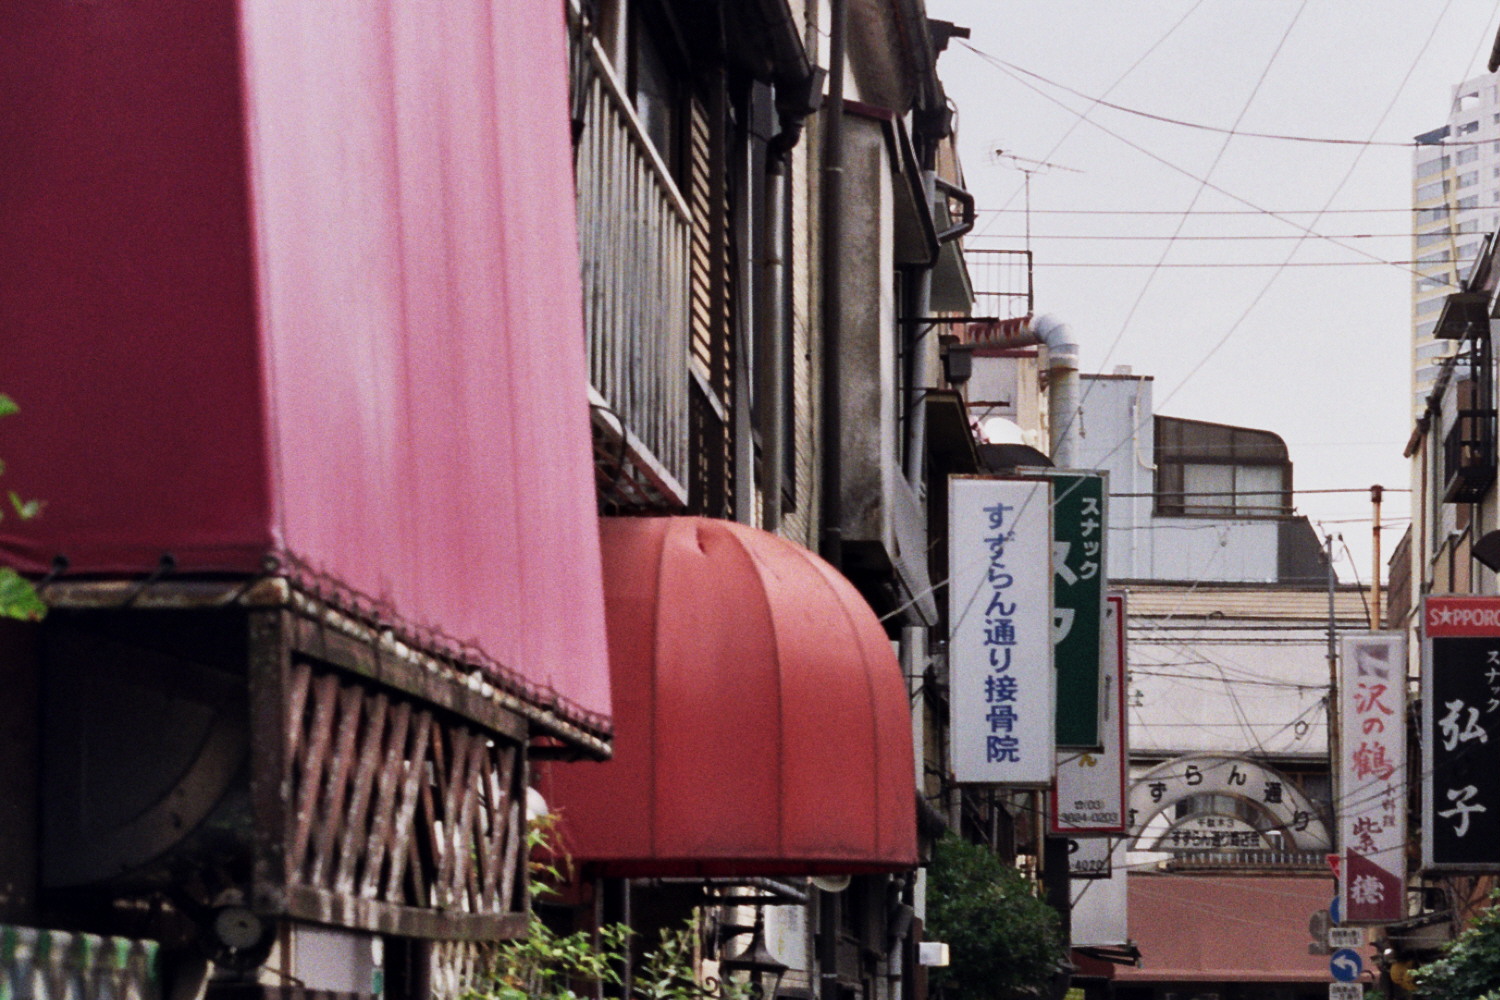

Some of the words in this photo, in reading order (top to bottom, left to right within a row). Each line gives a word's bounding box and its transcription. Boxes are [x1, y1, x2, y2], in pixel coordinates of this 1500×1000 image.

[1079, 497, 1100, 580] スナック
[983, 502, 1020, 763] すずらん通り接骨院
[1485, 650, 1500, 714] スナック
[1352, 682, 1394, 781] 沢の鶴
[1438, 698, 1489, 838] 弘子
